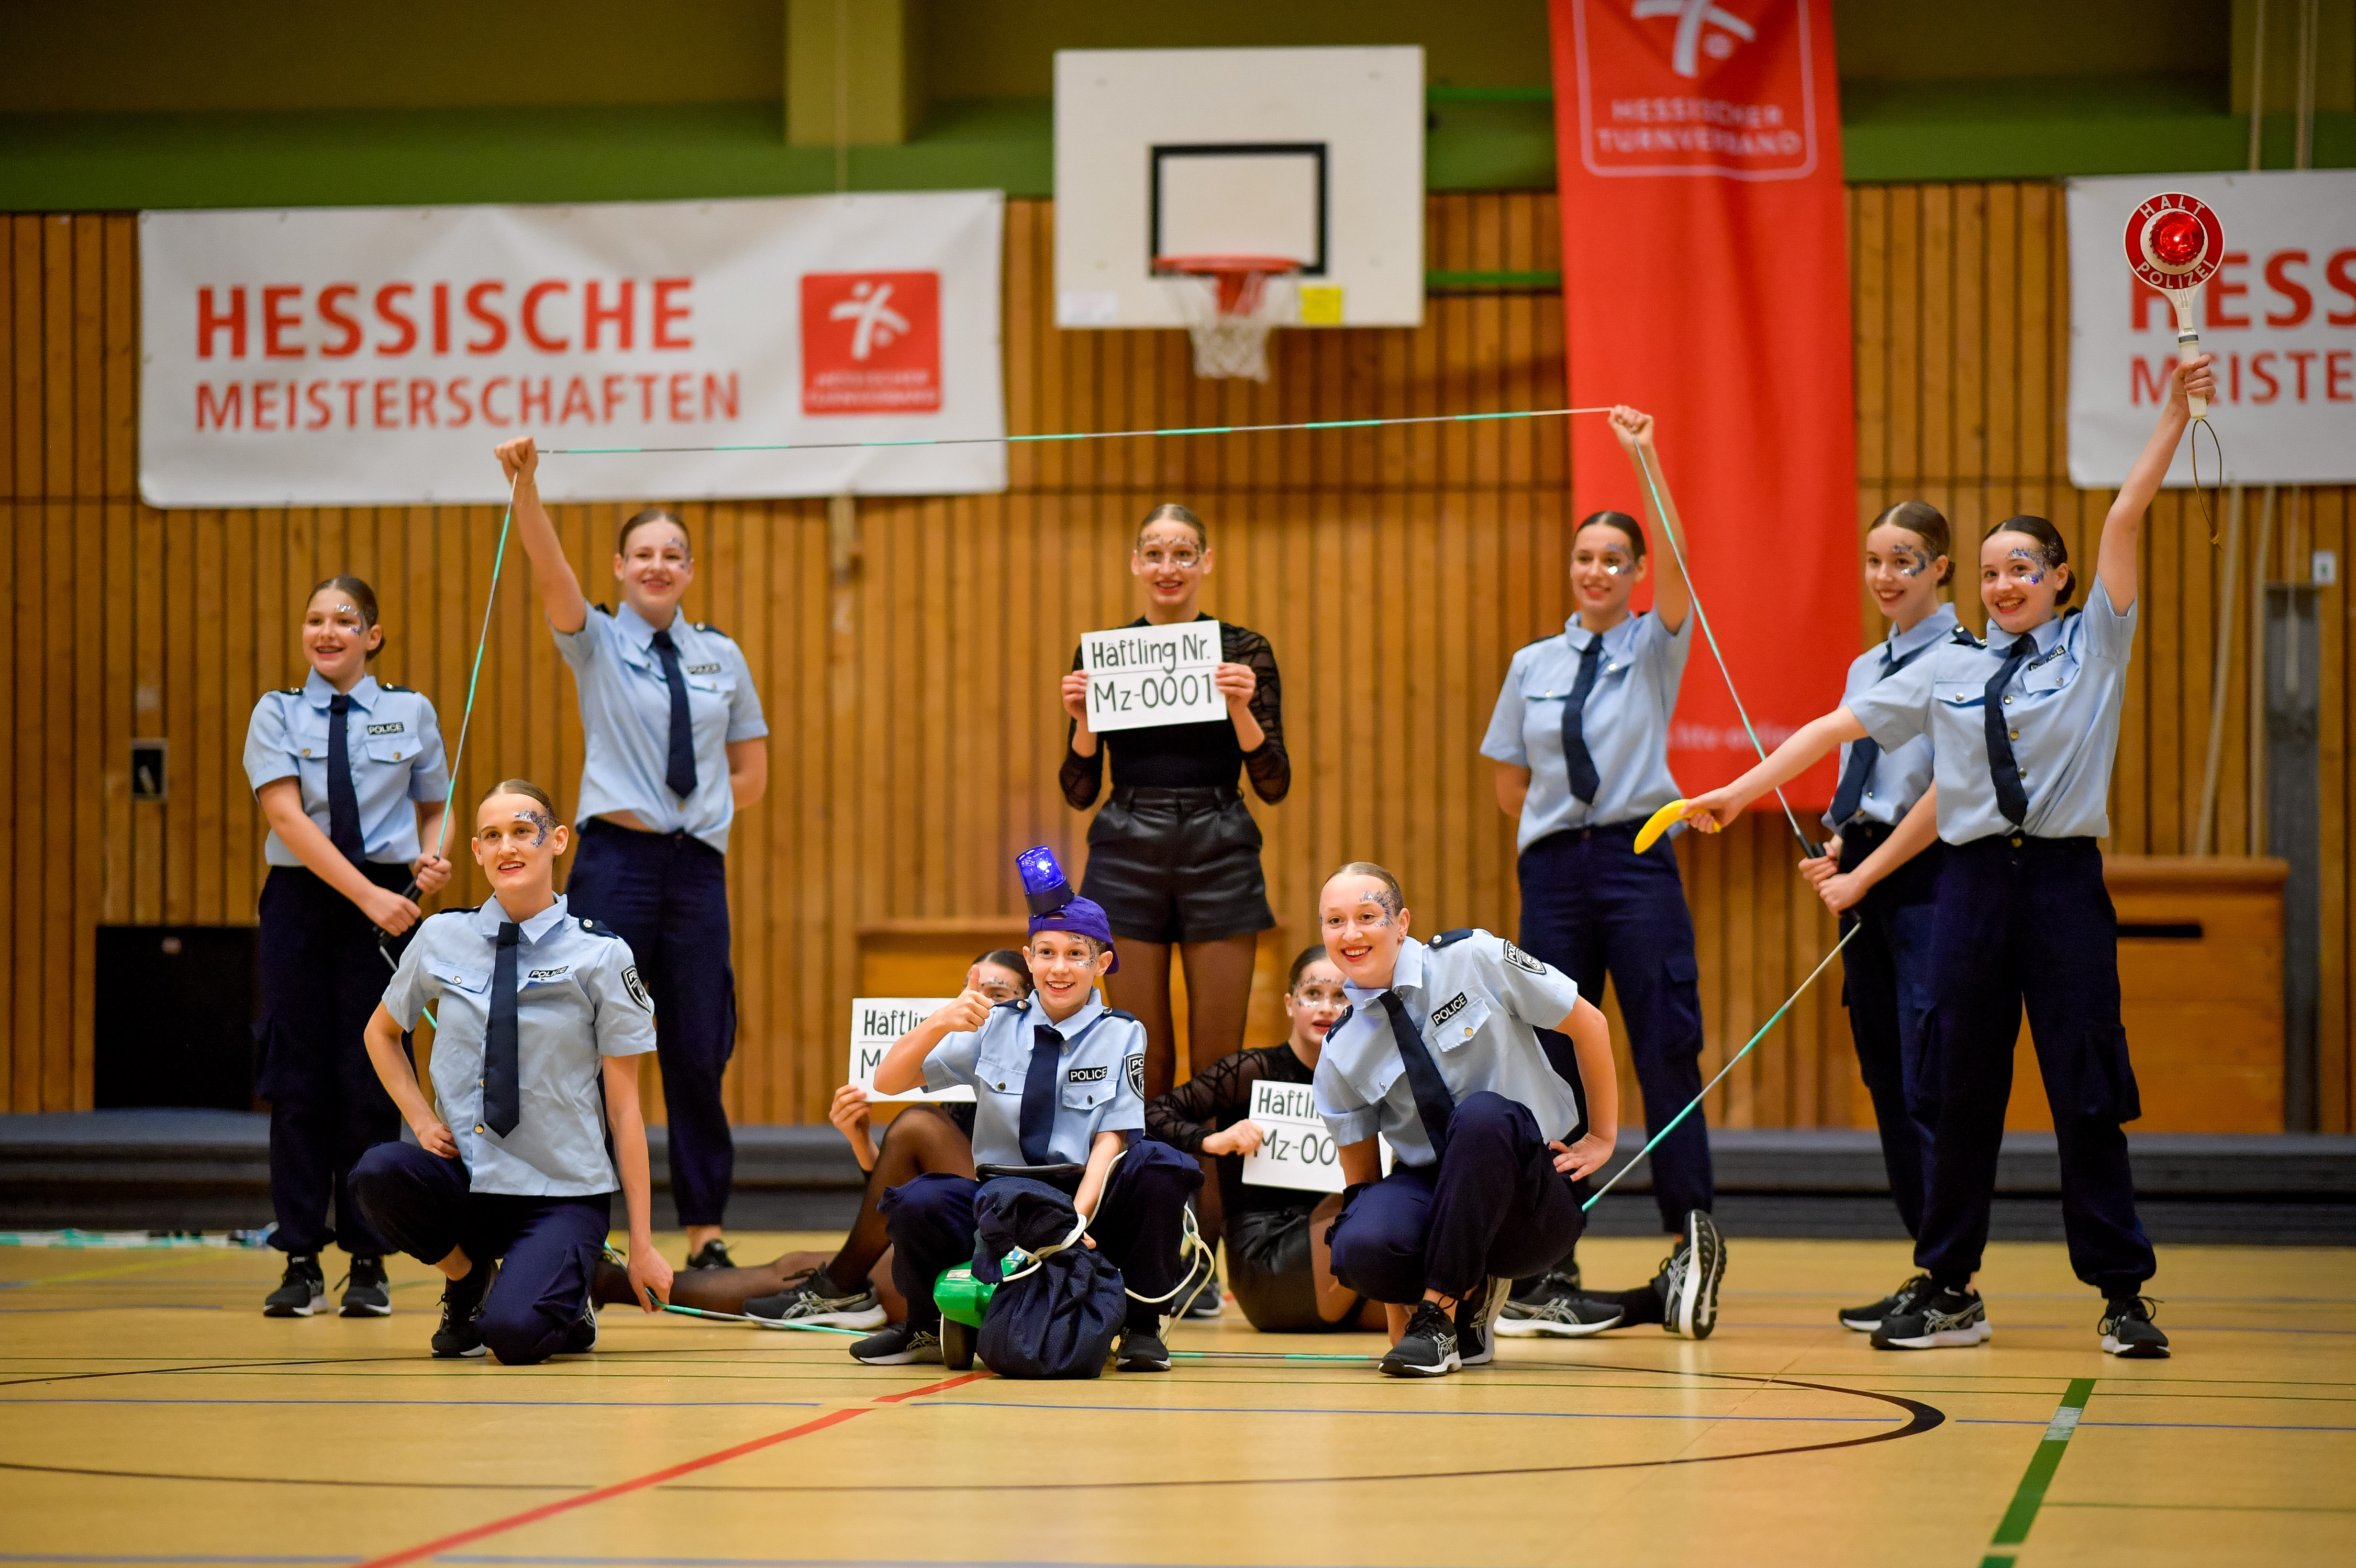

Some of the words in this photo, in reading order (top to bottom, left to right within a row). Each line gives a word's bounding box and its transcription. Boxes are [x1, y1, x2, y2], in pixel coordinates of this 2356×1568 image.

[2139, 195, 2205, 218] HALT
[2136, 260, 2215, 288] POLIZEI
[196, 277, 693, 359] HESSISCHE
[2131, 350, 2354, 405] MISTE
[196, 374, 739, 430] MEISTERSCHAFTEN
[1092, 639, 1176, 674] Häftling
[1182, 633, 1210, 661] Nr.
[1094, 673, 1212, 713] Mz-0001
[368, 722, 403, 734] POLICE
[530, 966, 568, 977] POLICE
[1432, 994, 1466, 1025] POLICE
[1070, 1067, 1107, 1081] POLICE
[1258, 1086, 1319, 1119] Häftli
